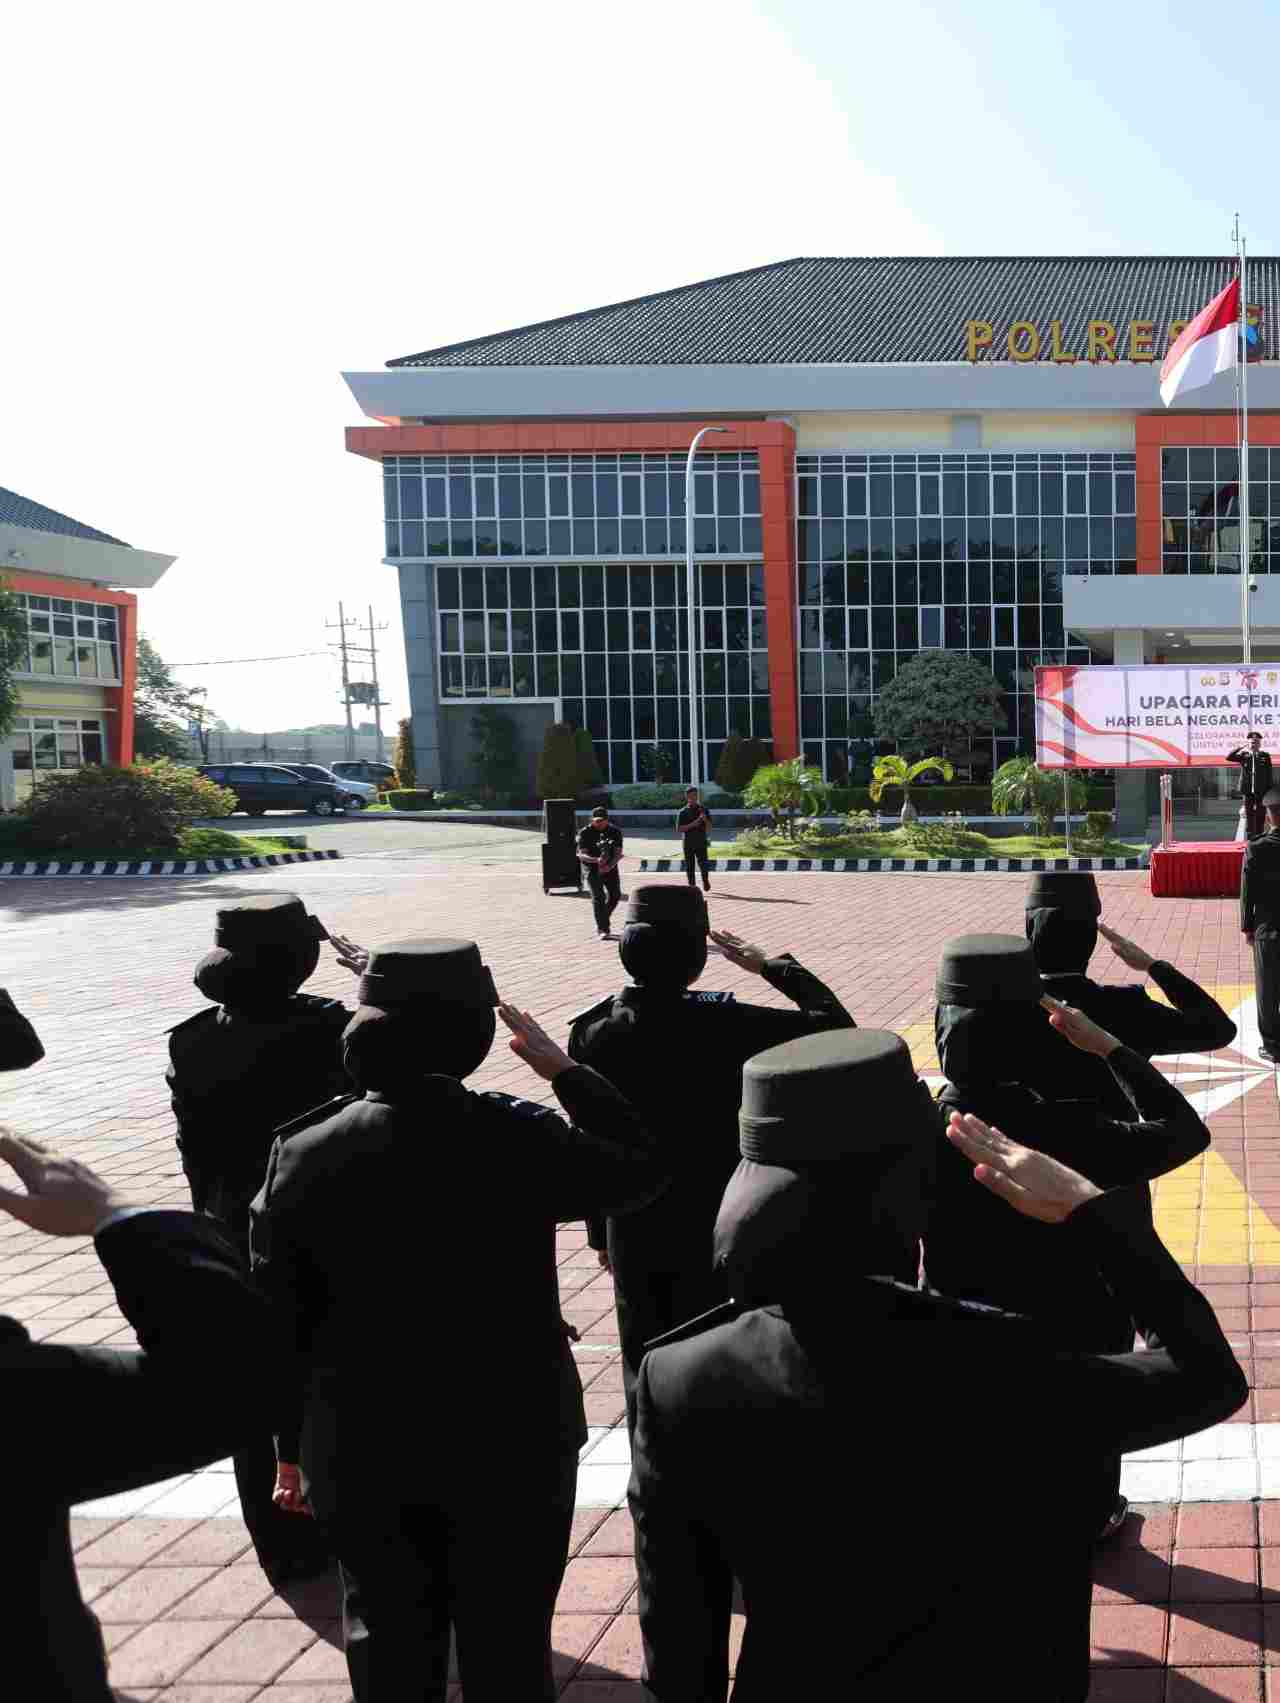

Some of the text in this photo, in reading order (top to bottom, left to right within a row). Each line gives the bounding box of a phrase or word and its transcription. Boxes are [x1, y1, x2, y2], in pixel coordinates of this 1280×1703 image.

[1140, 695, 1231, 710] UPACARA
[1105, 715, 1141, 727] HARI
[1145, 715, 1183, 727] BELA
[1187, 714, 1250, 727] NEGARA
[1254, 714, 1273, 725] KE
